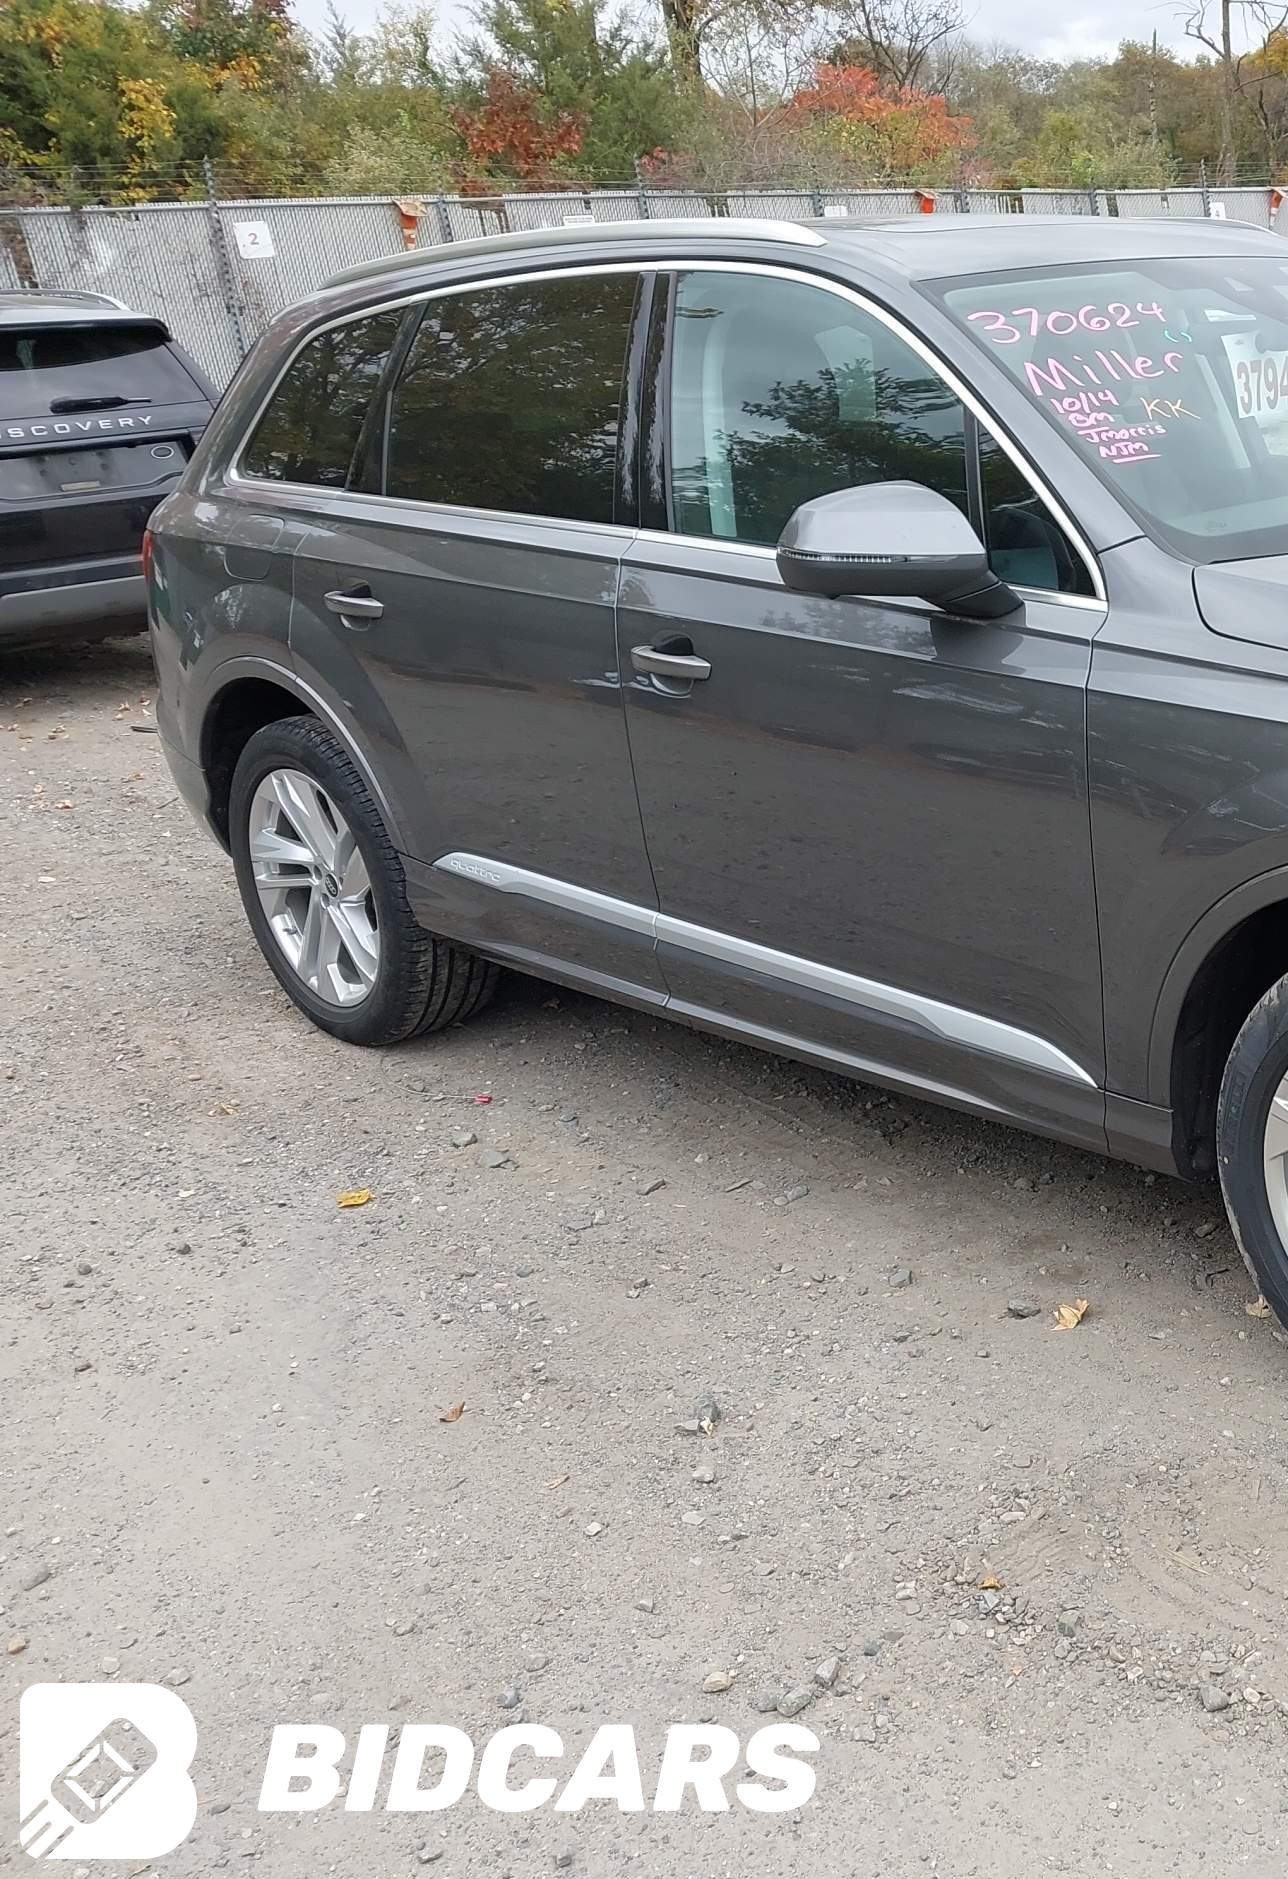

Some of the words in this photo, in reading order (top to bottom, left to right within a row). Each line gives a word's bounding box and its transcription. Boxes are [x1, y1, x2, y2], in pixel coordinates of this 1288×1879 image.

[248, 232, 260, 246] 2
[967, 302, 1167, 344] 370624
[1023, 350, 1184, 396] Miller
[1050, 389, 1120, 413] 10/14
[1139, 397, 1201, 420] KK
[0, 415, 152, 438] SCOVERY
